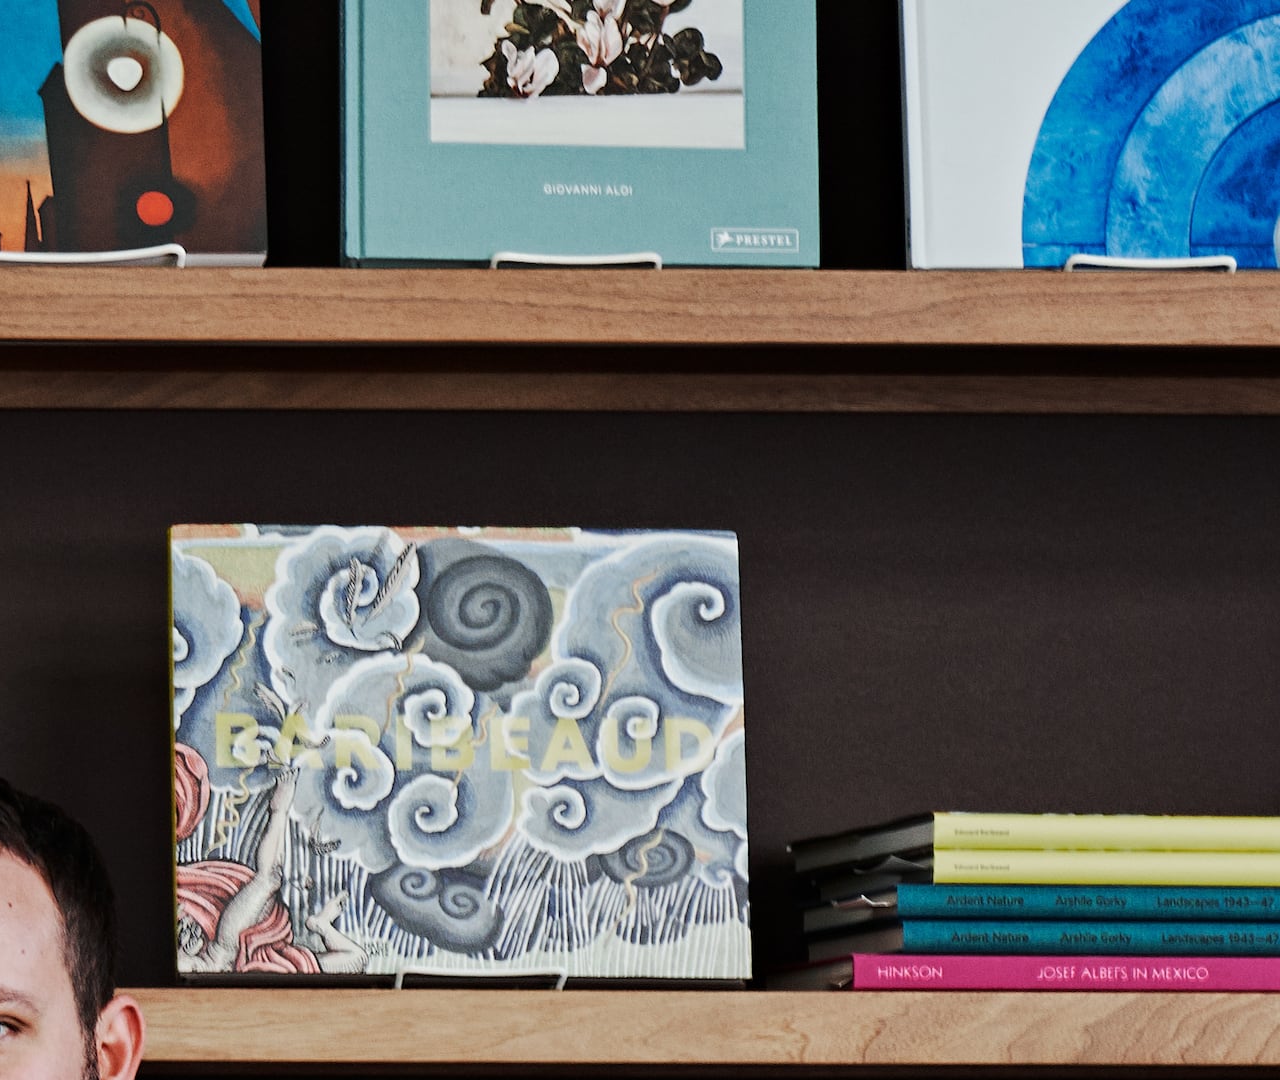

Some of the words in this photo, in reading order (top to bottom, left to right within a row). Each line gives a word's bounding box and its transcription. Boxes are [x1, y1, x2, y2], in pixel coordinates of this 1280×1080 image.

[543, 183, 602, 197] GIOVANNI
[605, 184, 633, 197] ALOI
[735, 232, 793, 248] PRESTEL
[215, 711, 714, 773] BARIBEAUD
[947, 894, 984, 906] Ardent
[987, 894, 1024, 906] Nature
[1054, 895, 1093, 907] Arshile
[1095, 895, 1127, 909] Gorky
[1156, 896, 1221, 910] Landscapes
[951, 932, 989, 943] Ardent
[991, 932, 1029, 943] Nature
[1060, 932, 1097, 944] Arshile
[1099, 933, 1131, 946] Gorky
[1161, 933, 1225, 946] Landscapes
[877, 965, 943, 980] HINKSON
[1036, 966, 1077, 981] JOSEF
[1080, 966, 1128, 981] ALBERS
[1132, 966, 1147, 981] IN
[1151, 966, 1208, 981] MEXICO
